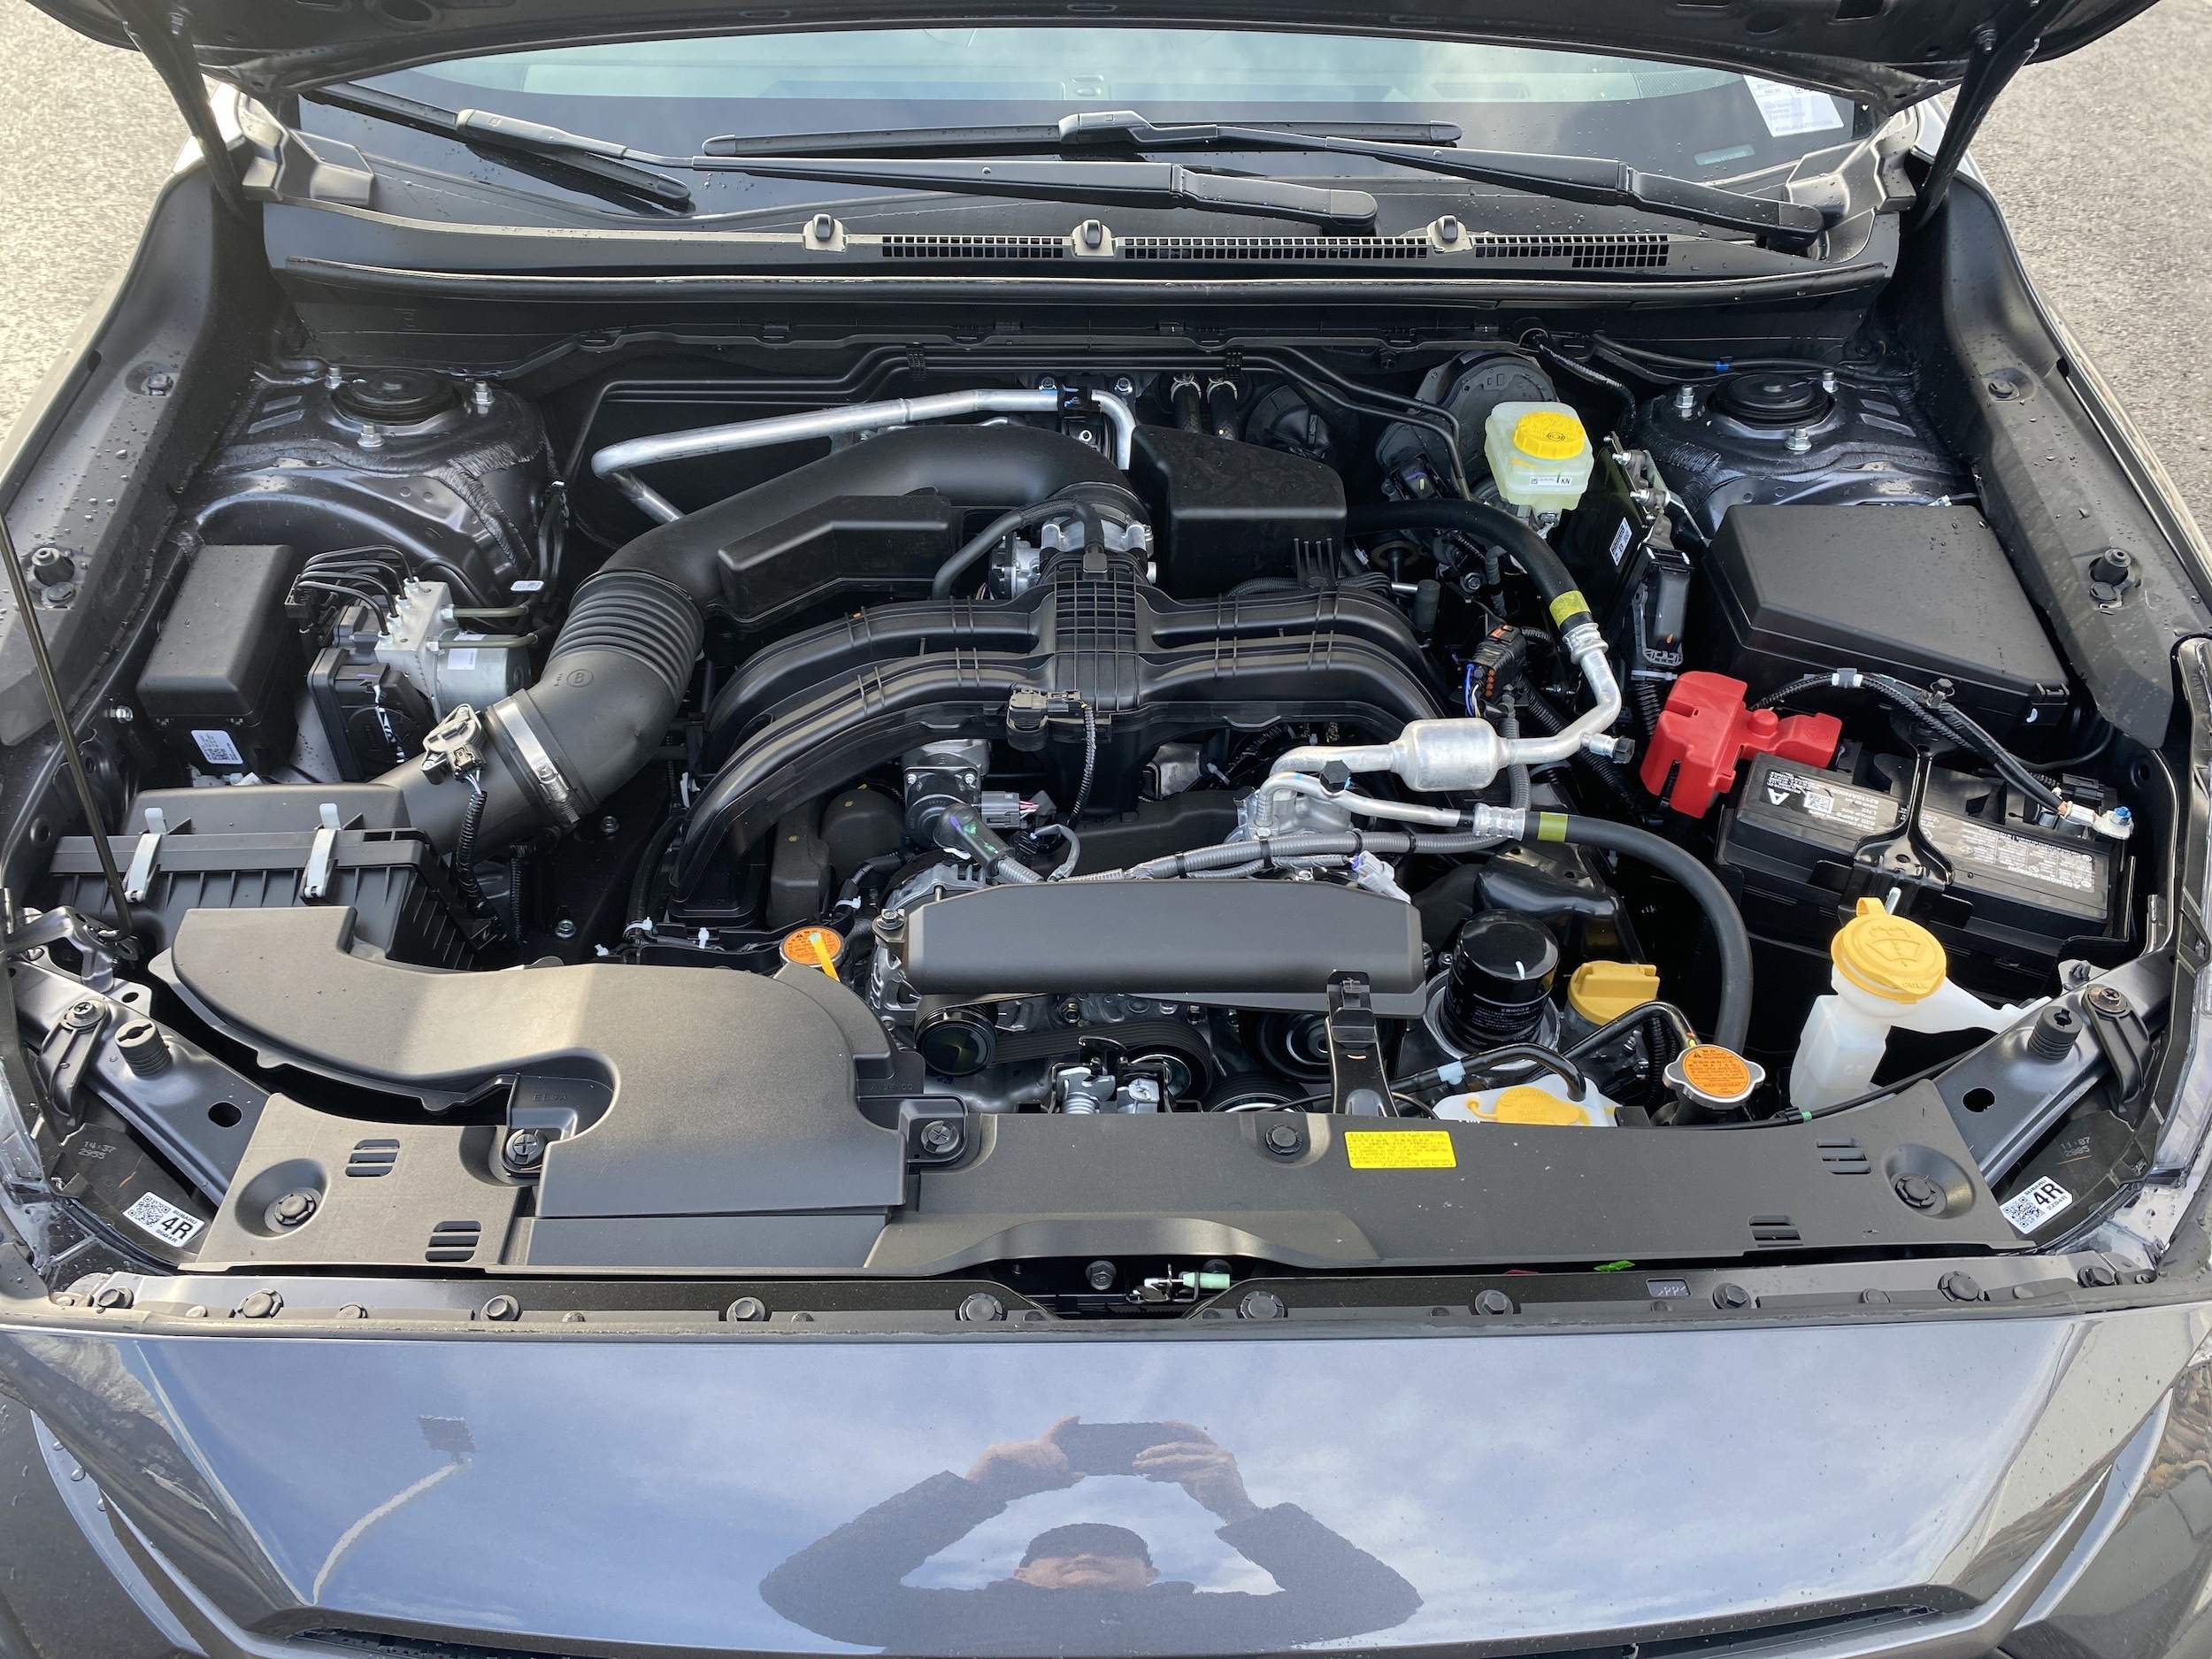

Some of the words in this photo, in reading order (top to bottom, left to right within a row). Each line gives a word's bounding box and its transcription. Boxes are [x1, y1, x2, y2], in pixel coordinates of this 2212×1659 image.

[573, 672, 584, 683] B
[1768, 787, 1790, 806] A
[1808, 810, 1826, 818] AMPS
[1825, 814, 1857, 826] CRANKING
[1836, 811, 1860, 822] AMPS
[1855, 811, 1877, 820] GROUP
[83, 1141, 118, 1153] 14:37
[78, 1148, 107, 1160] 2955
[2024, 1179, 2047, 1195] SUBARU
[2033, 1182, 2065, 1205] 4R
[172, 1209, 198, 1225] SUBARU
[160, 1216, 194, 1240] 4R
